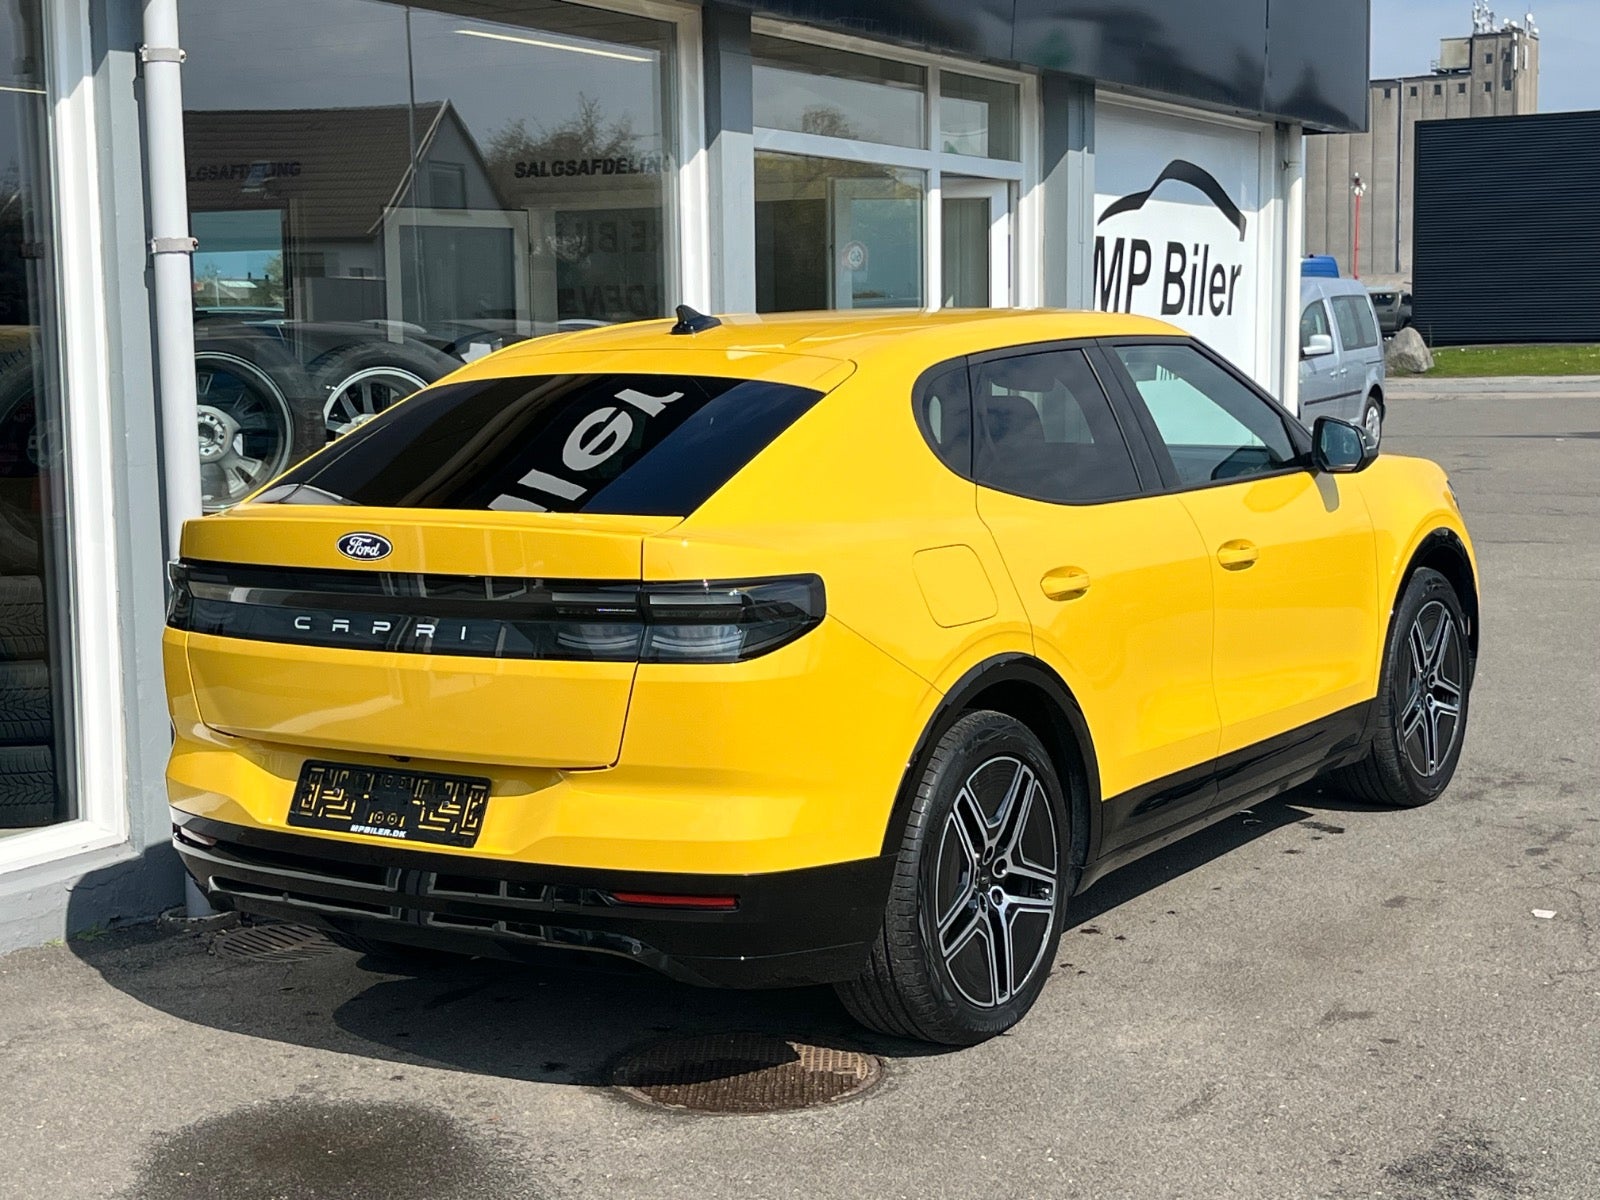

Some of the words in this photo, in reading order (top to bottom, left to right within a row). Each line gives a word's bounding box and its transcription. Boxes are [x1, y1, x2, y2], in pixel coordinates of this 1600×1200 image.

[1093, 235, 1152, 314] MP
[1161, 241, 1243, 317] Biler
[346, 536, 381, 557] Ford
[294, 616, 467, 641] CAPRI
[350, 824, 407, 838] MPBILER.DK
